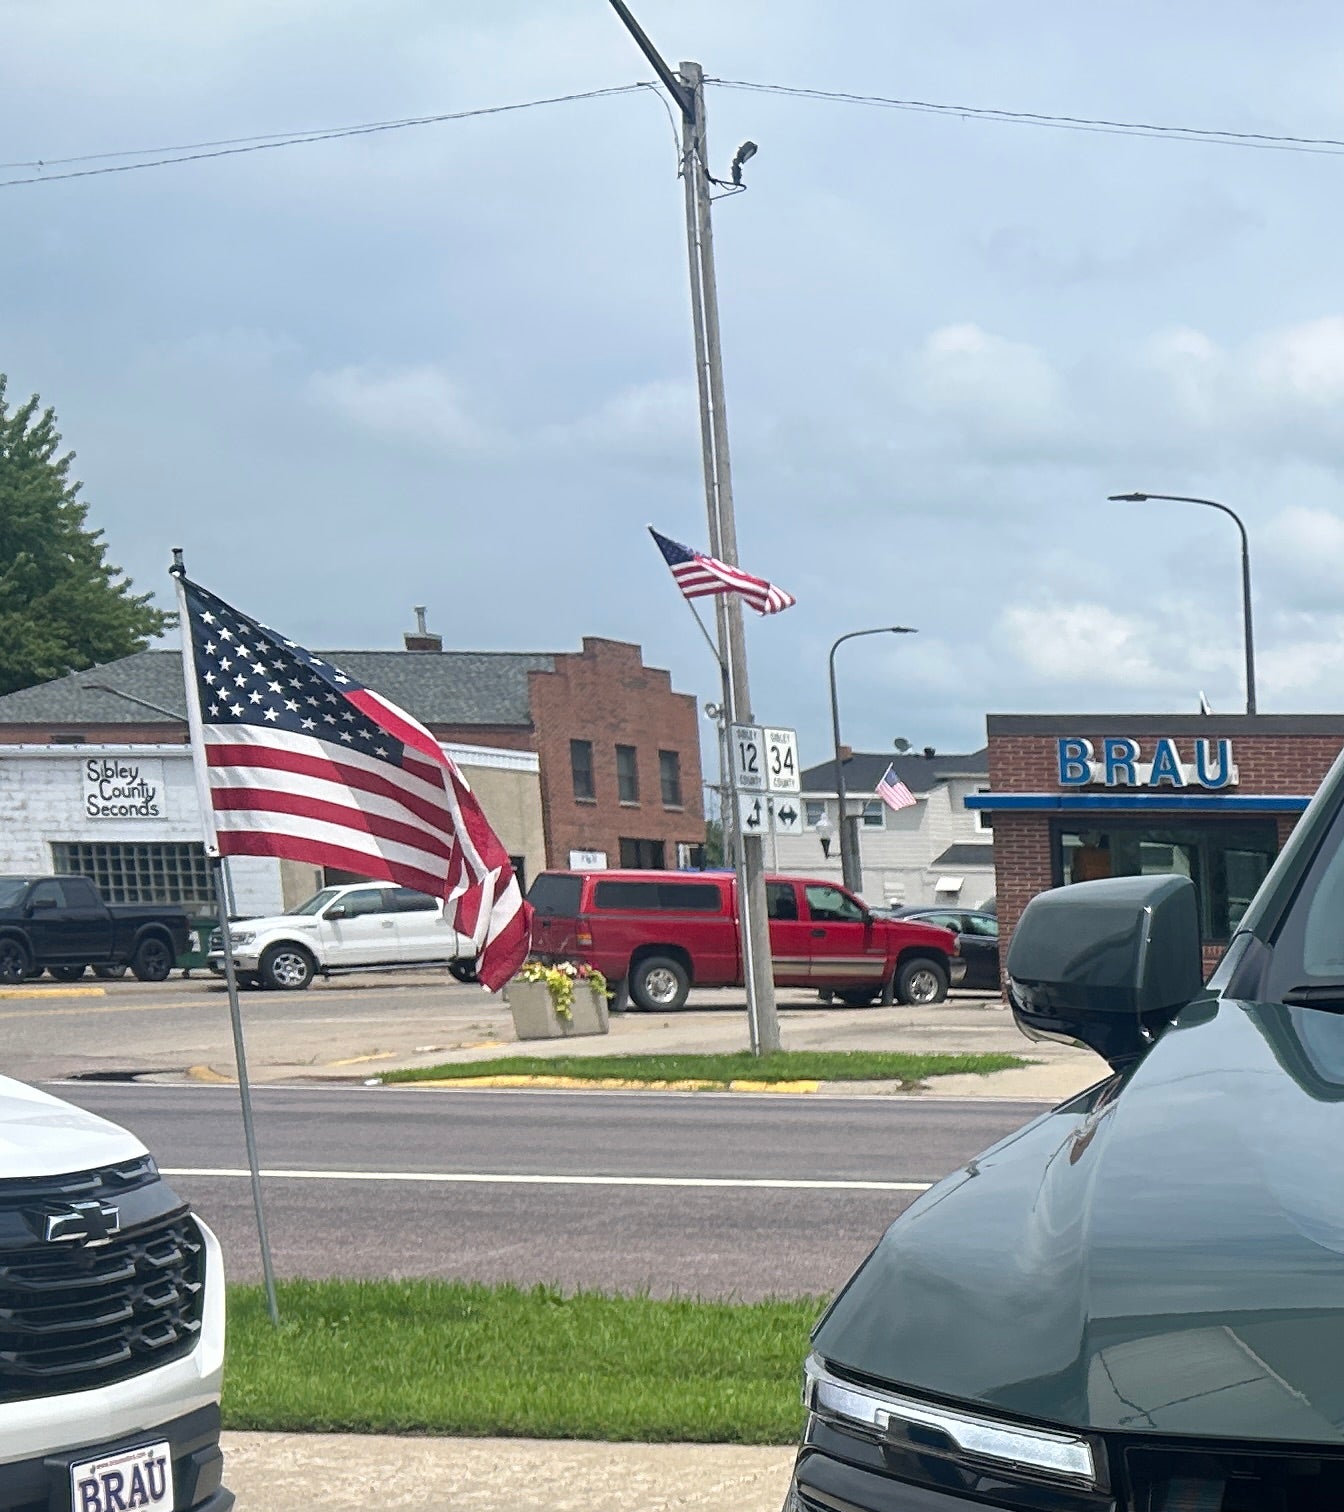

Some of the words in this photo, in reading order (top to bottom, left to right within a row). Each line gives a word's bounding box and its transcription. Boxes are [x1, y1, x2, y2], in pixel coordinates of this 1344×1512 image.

[740, 742, 758, 773] 12
[771, 745, 794, 776] 34
[1057, 737, 1233, 790] BRAU
[87, 759, 139, 785] Sibley
[87, 794, 160, 816] Seconds
[99, 778, 156, 804] County
